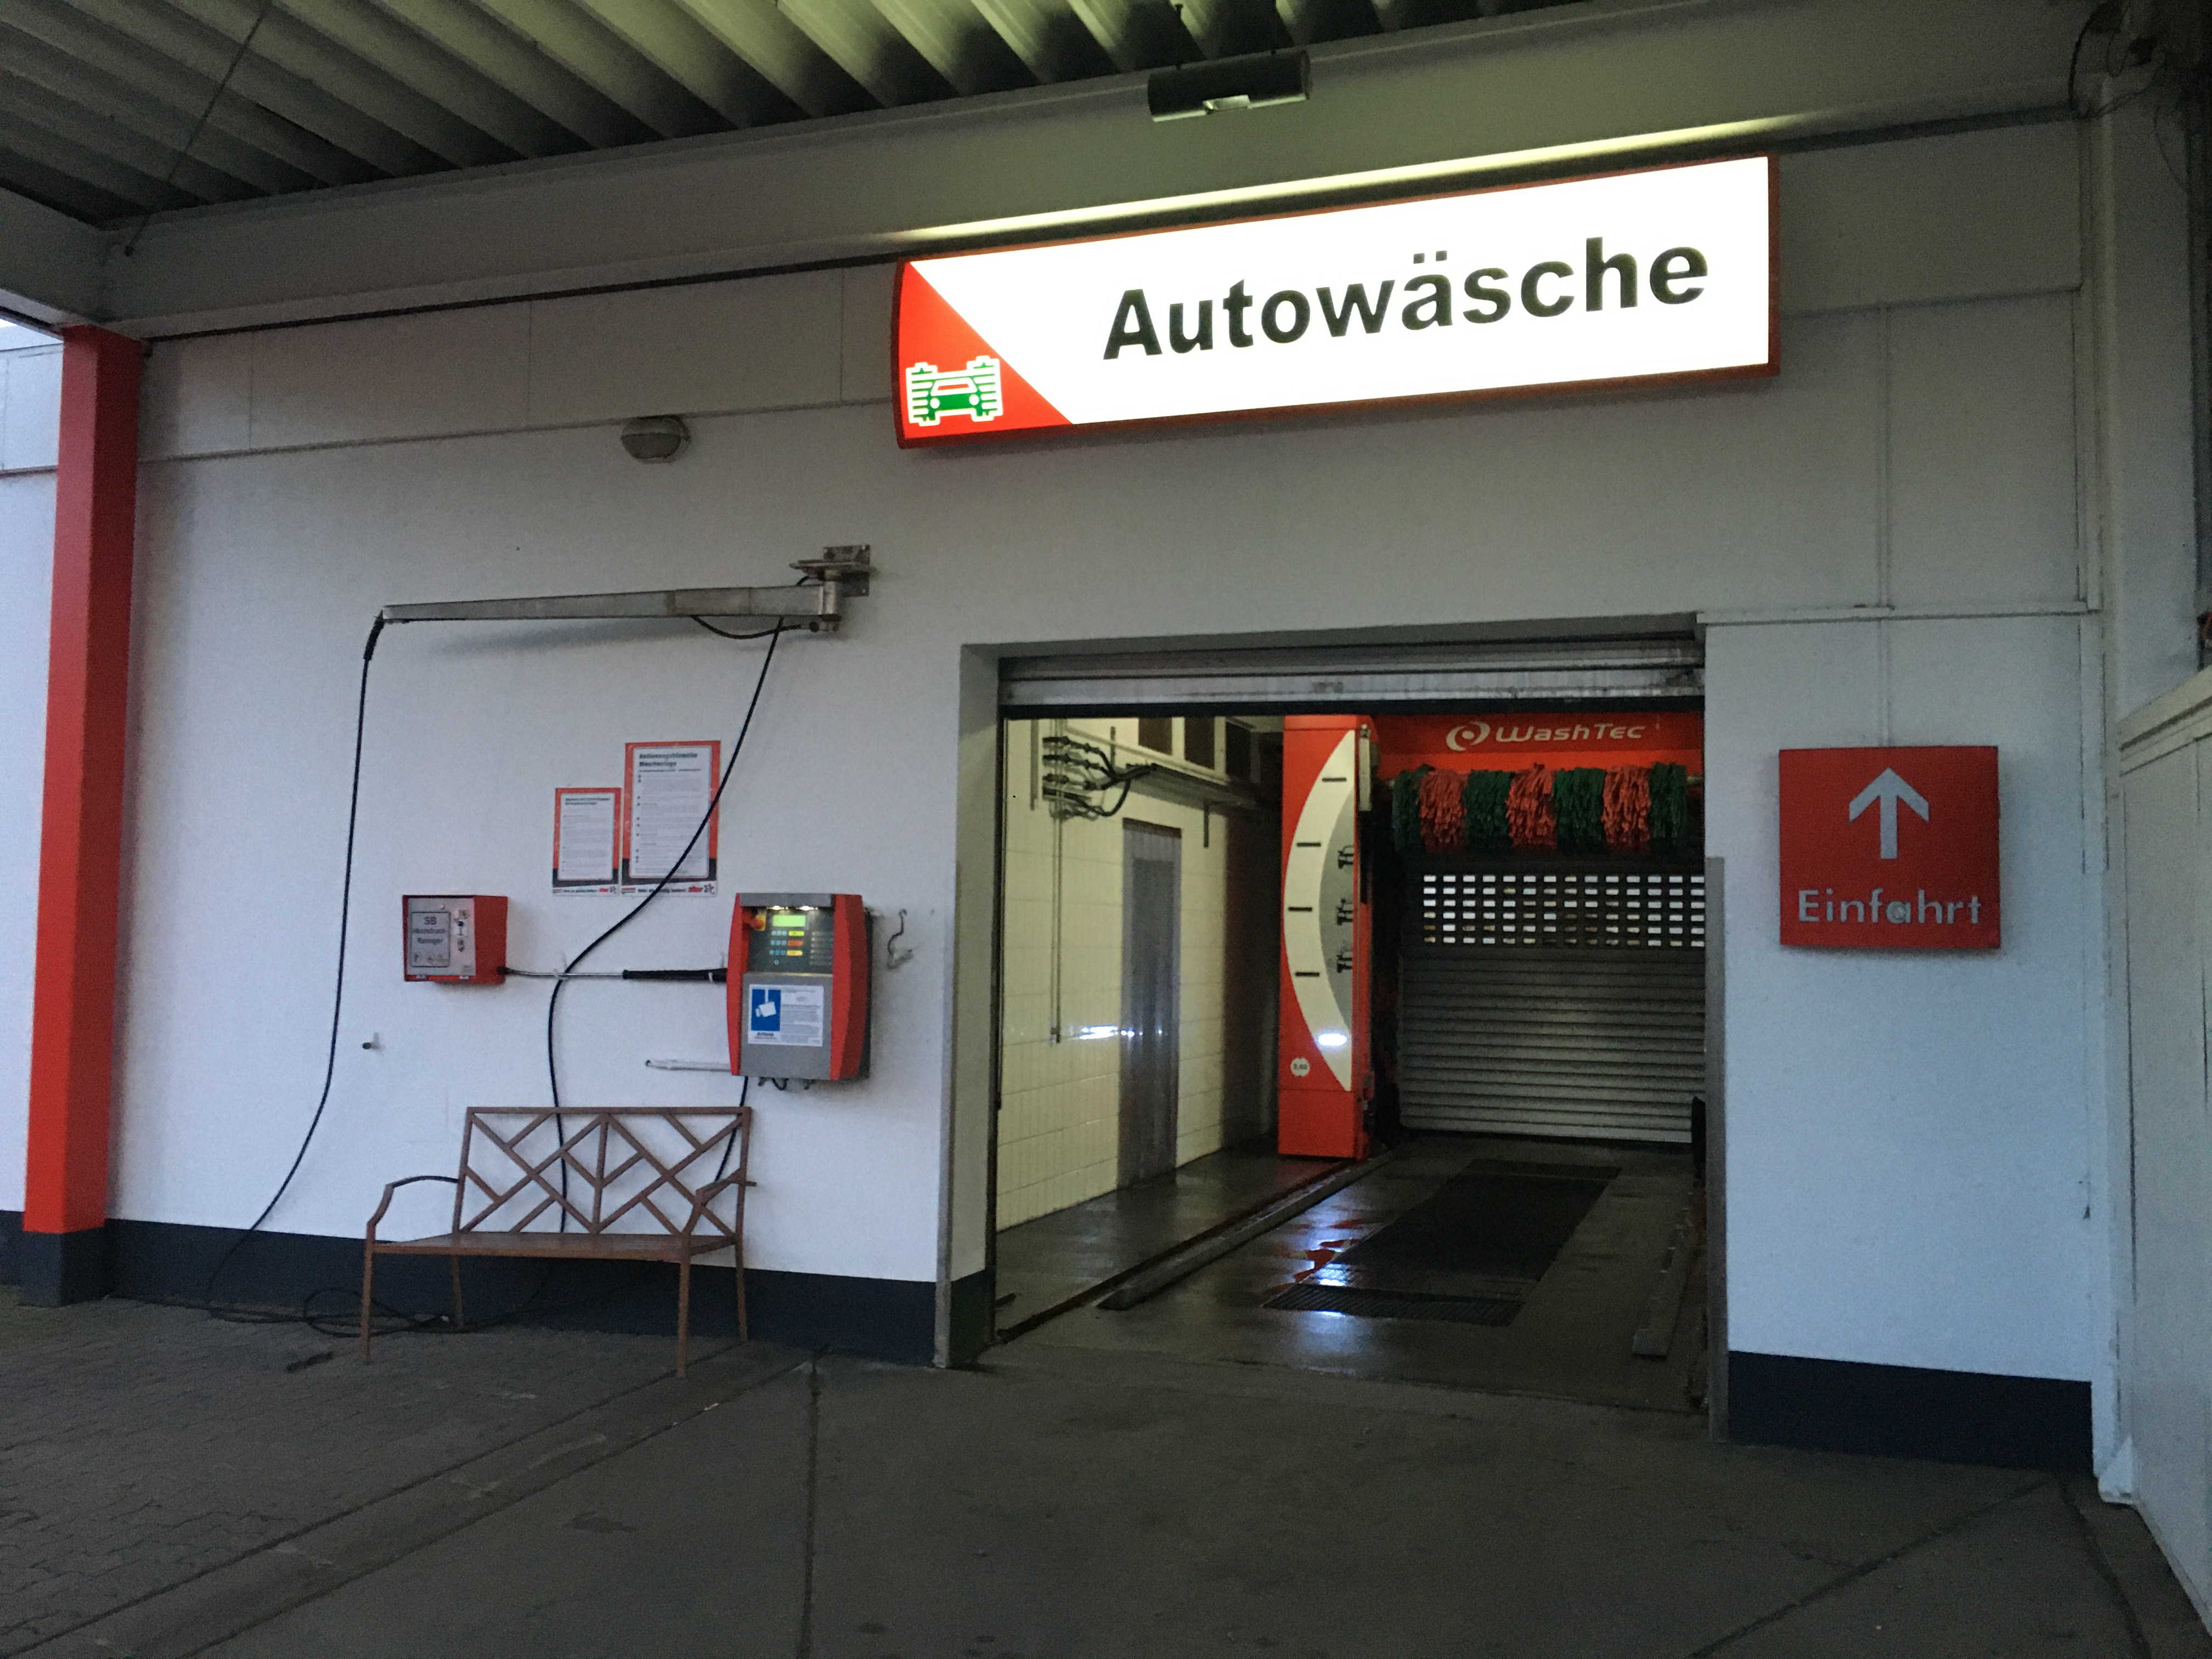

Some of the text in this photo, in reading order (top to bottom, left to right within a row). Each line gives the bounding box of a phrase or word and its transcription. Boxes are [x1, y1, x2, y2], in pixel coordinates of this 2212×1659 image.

[1103, 236, 1708, 359] Autowäsche
[1496, 724, 1646, 742] WashTec
[1798, 888, 1982, 925] Einfahrt
[424, 916, 437, 925] SB
